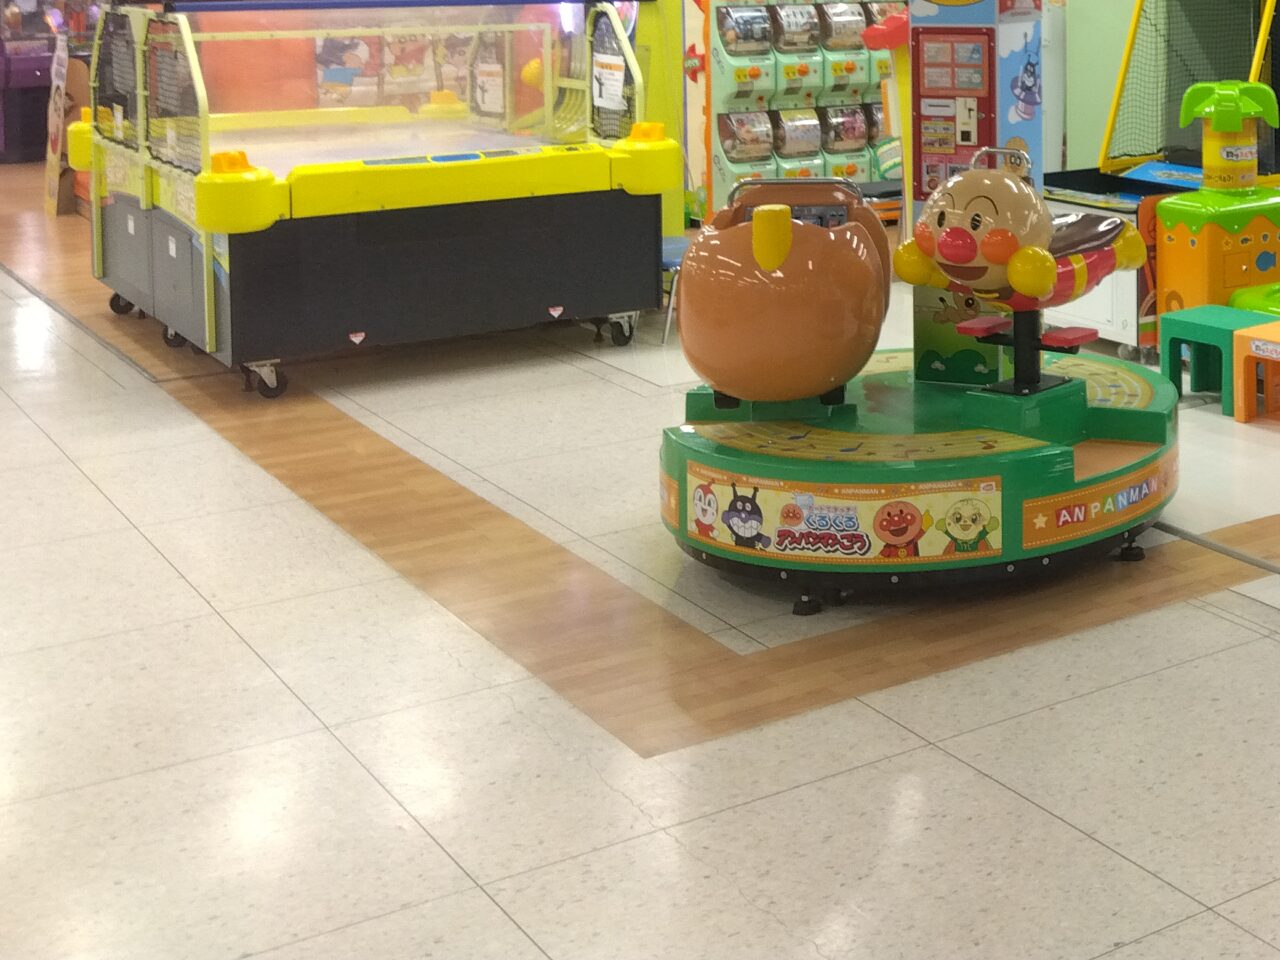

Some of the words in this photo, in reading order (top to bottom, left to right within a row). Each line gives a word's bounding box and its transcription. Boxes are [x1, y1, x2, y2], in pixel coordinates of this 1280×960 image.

[1057, 478, 1158, 527] ANPANMAN
[805, 513, 858, 530] くるくる
